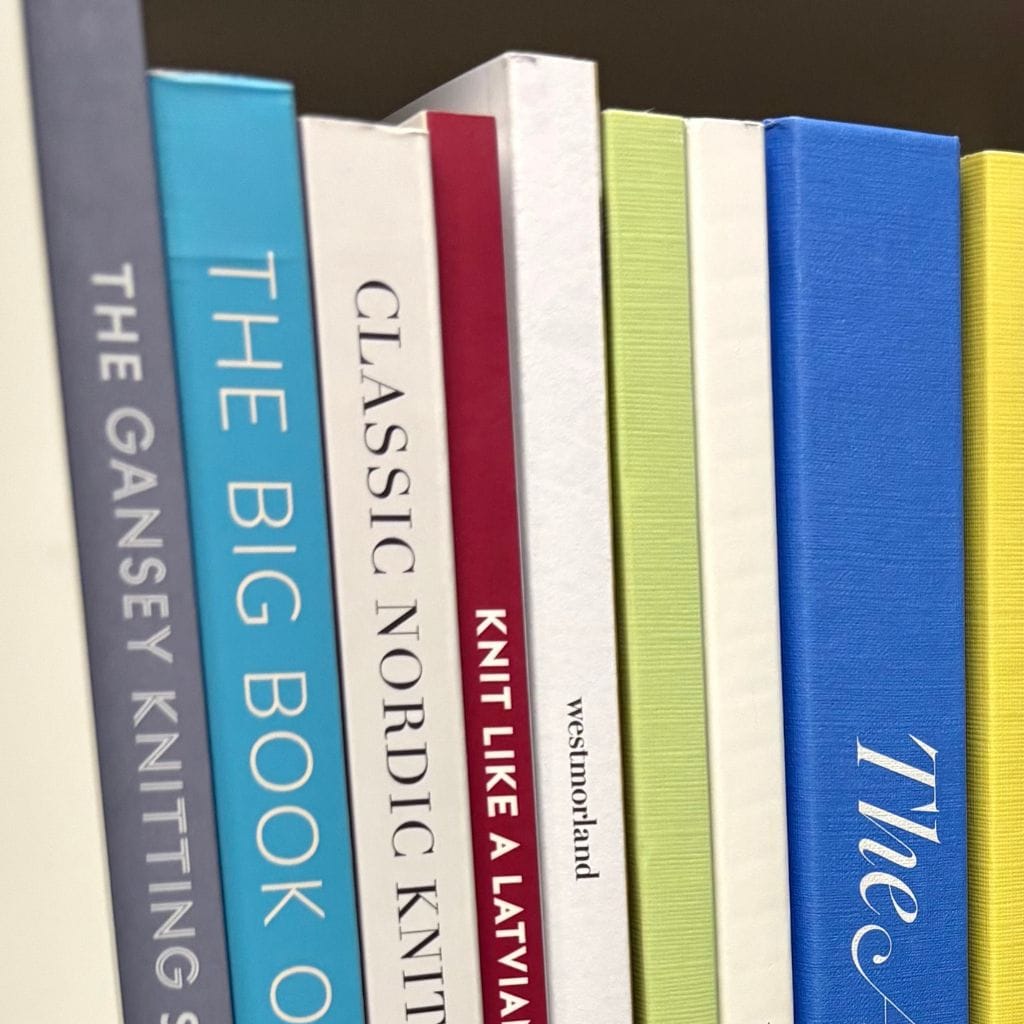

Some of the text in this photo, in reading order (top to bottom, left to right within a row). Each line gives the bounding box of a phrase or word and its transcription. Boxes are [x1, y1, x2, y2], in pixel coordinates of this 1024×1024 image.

[90, 263, 143, 382] THE
[208, 251, 287, 432] THE
[355, 279, 418, 576] CLASSIC
[105, 407, 173, 665] GANSEY
[227, 480, 301, 625] BIG
[374, 599, 437, 859] NORDIC
[475, 608, 513, 710] KNIT
[131, 689, 200, 990] KNITTING
[243, 671, 325, 926] BOOK
[482, 725, 519, 818] LIKE
[488, 831, 519, 860] A
[566, 696, 600, 881] westmorland
[856, 733, 941, 924] The
